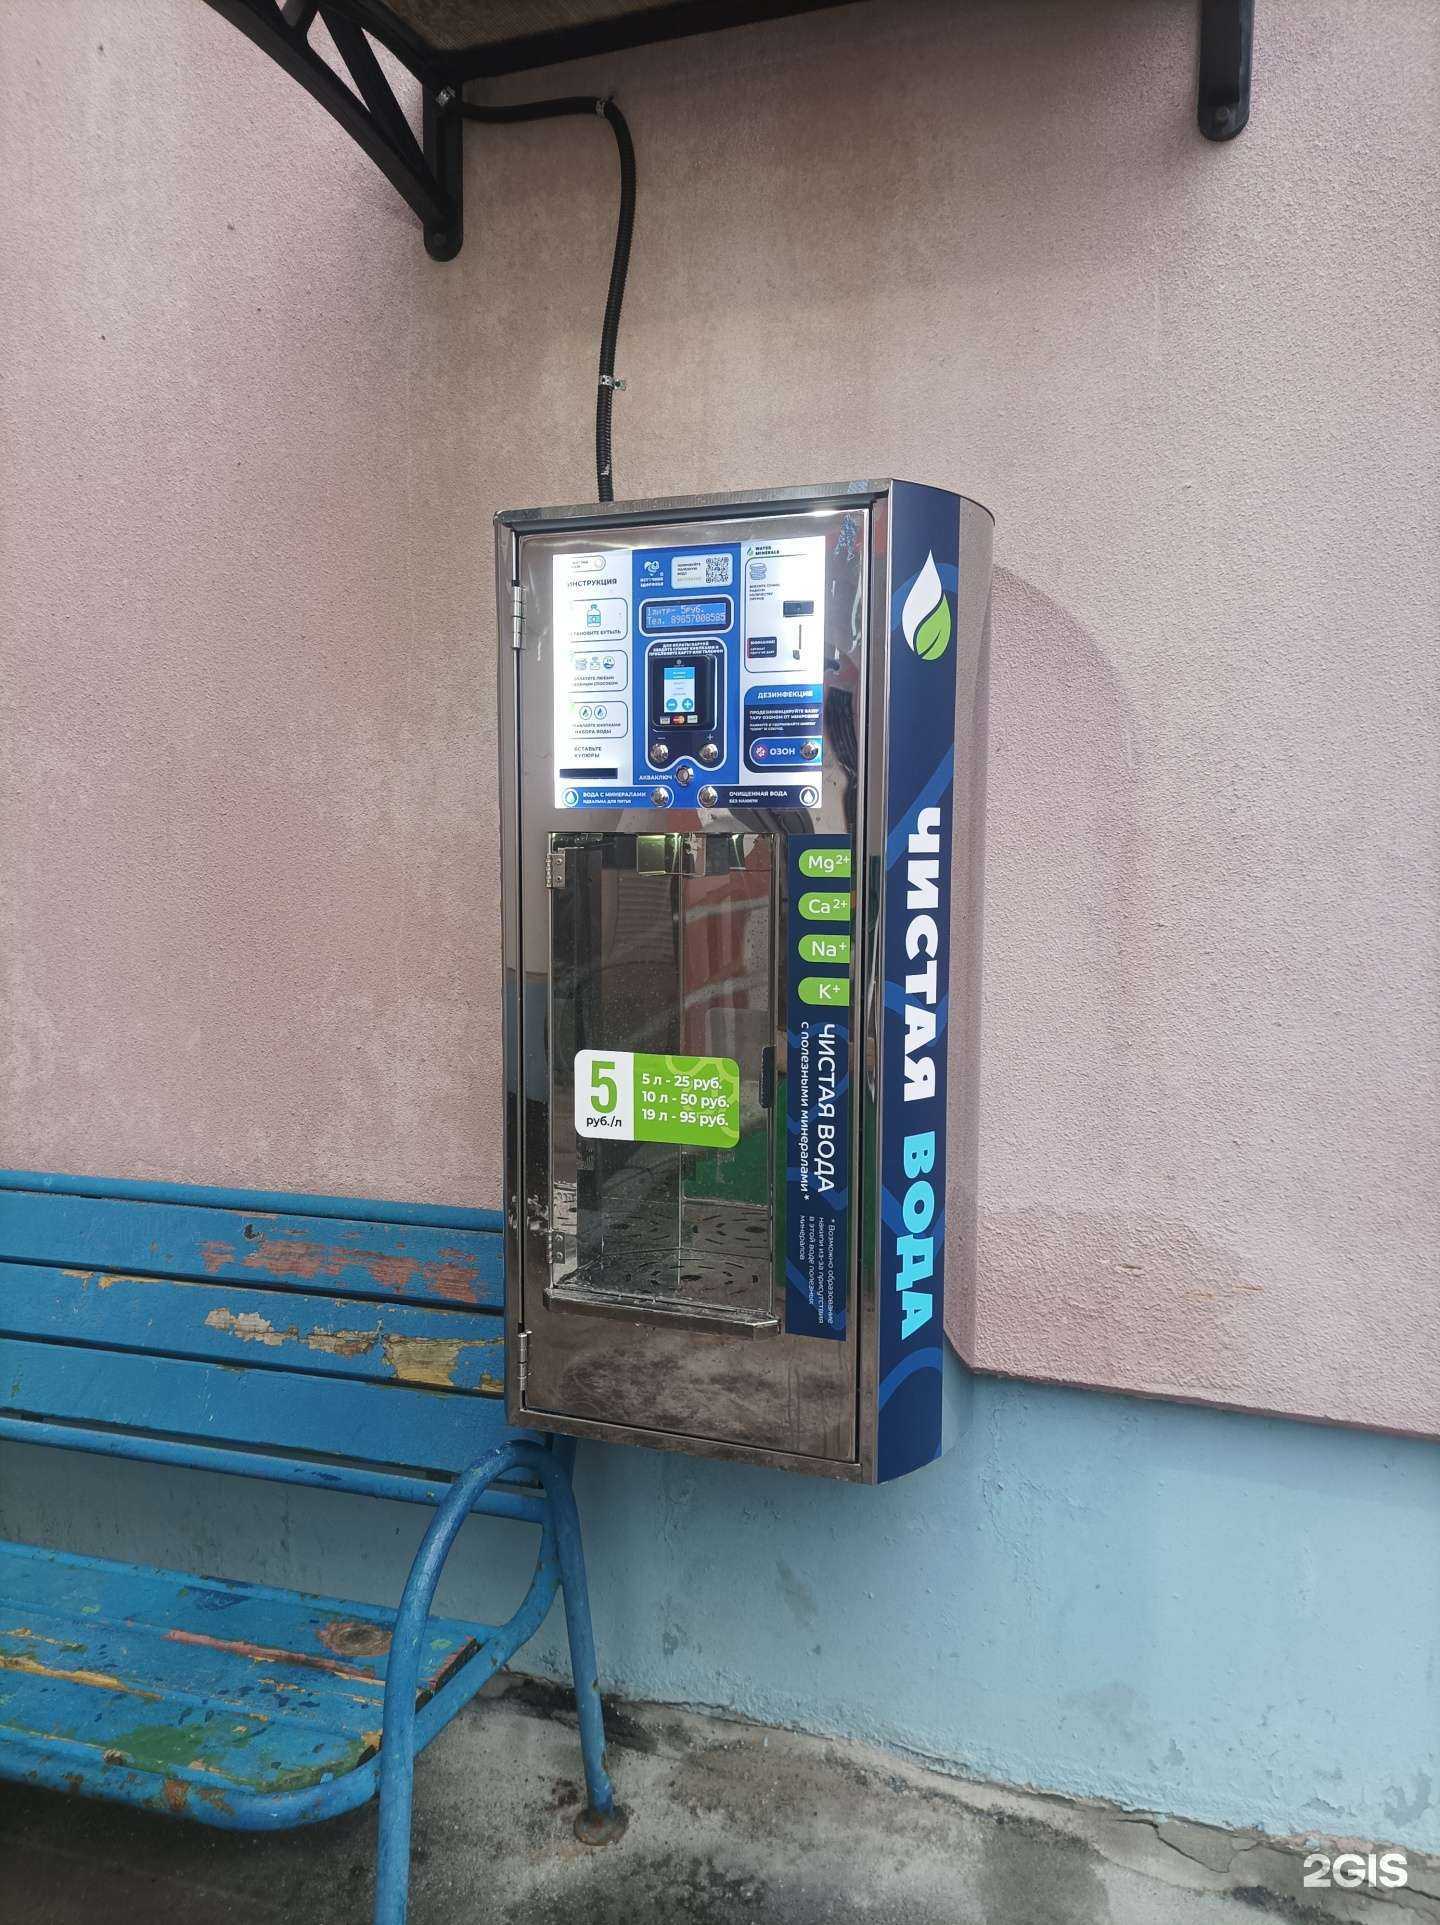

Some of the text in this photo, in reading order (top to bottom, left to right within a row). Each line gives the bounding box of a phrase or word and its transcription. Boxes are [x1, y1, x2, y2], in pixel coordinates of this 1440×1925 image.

[769, 747, 796, 756] ОЗОН
[801, 1021, 810, 1029] с
[801, 1031, 810, 1107] полезными
[896, 807, 941, 1341] ЧИСТАЯ ВОДА
[590, 1060, 618, 1114] 5
[642, 1073, 650, 1085] 5
[652, 1076, 662, 1085] л
[674, 1075, 690, 1088] 25
[693, 1076, 723, 1091] руб.
[642, 1091, 656, 1103] 10
[659, 1094, 668, 1104] л
[680, 1093, 698, 1106] 50
[701, 1095, 730, 1109] руб.
[814, 1024, 836, 1193] ЧИСТАЯ ВОДА
[586, 1116, 622, 1128] руб./л
[642, 1109, 656, 1121] 19
[659, 1112, 668, 1121] л
[680, 1111, 696, 1124] 95
[700, 1113, 729, 1127] руб.
